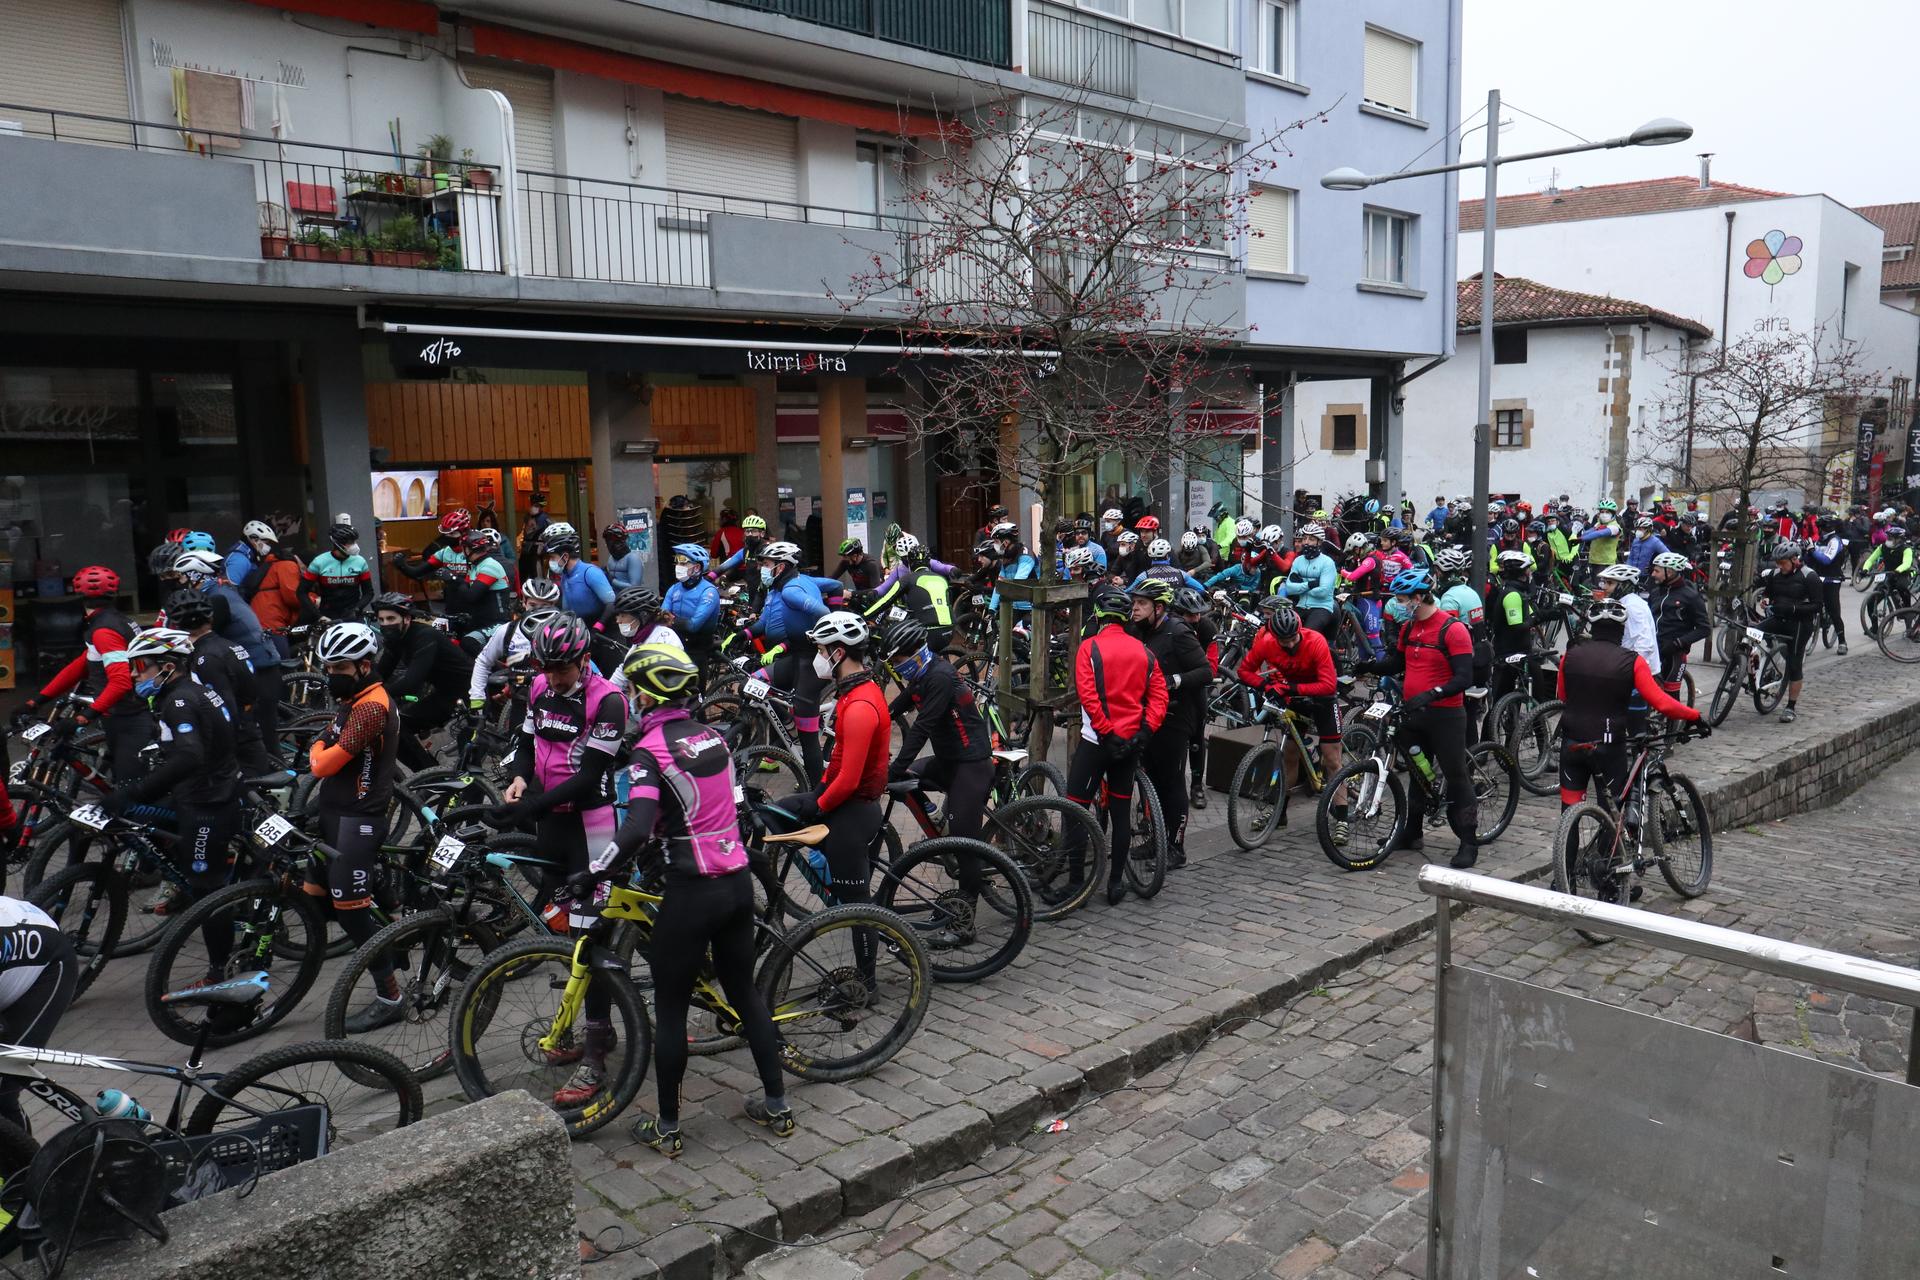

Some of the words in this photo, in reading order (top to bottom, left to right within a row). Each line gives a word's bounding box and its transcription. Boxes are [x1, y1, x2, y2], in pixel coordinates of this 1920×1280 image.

[420, 337, 461, 364] 18/70
[747, 683, 765, 697] 120
[194, 826, 210, 861] azcue
[259, 822, 282, 841] 285
[0, 930, 42, 962] ALTO
[29, 1079, 84, 1122] ORB
